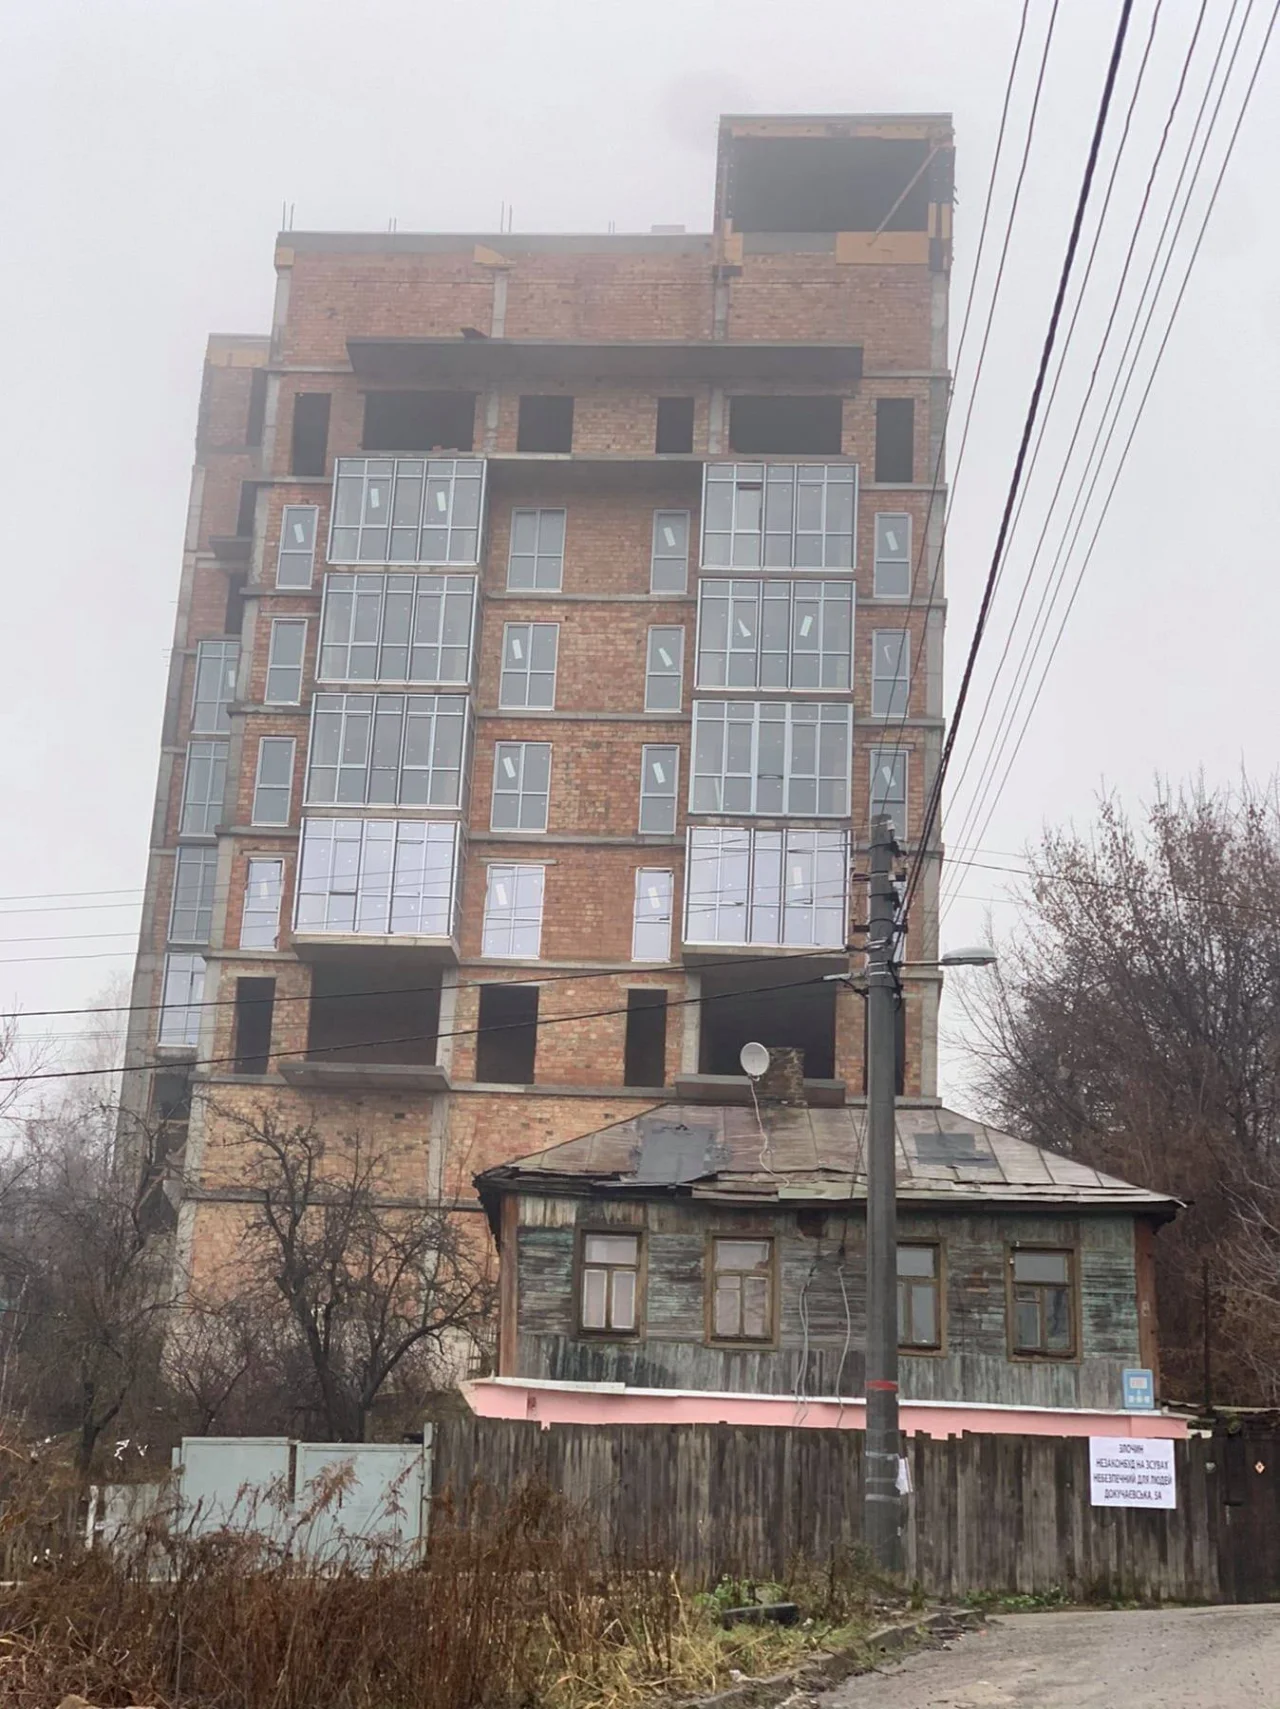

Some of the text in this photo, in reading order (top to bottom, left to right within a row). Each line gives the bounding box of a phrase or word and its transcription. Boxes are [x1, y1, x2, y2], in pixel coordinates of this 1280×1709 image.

[1119, 1444, 1144, 1453] ЗЛОЧИН
[1137, 1461, 1145, 1469] НА
[1094, 1474, 1136, 1484] НЕБЕЗПЕЧНИЙ
[1137, 1475, 1149, 1485] ДЛЯ
